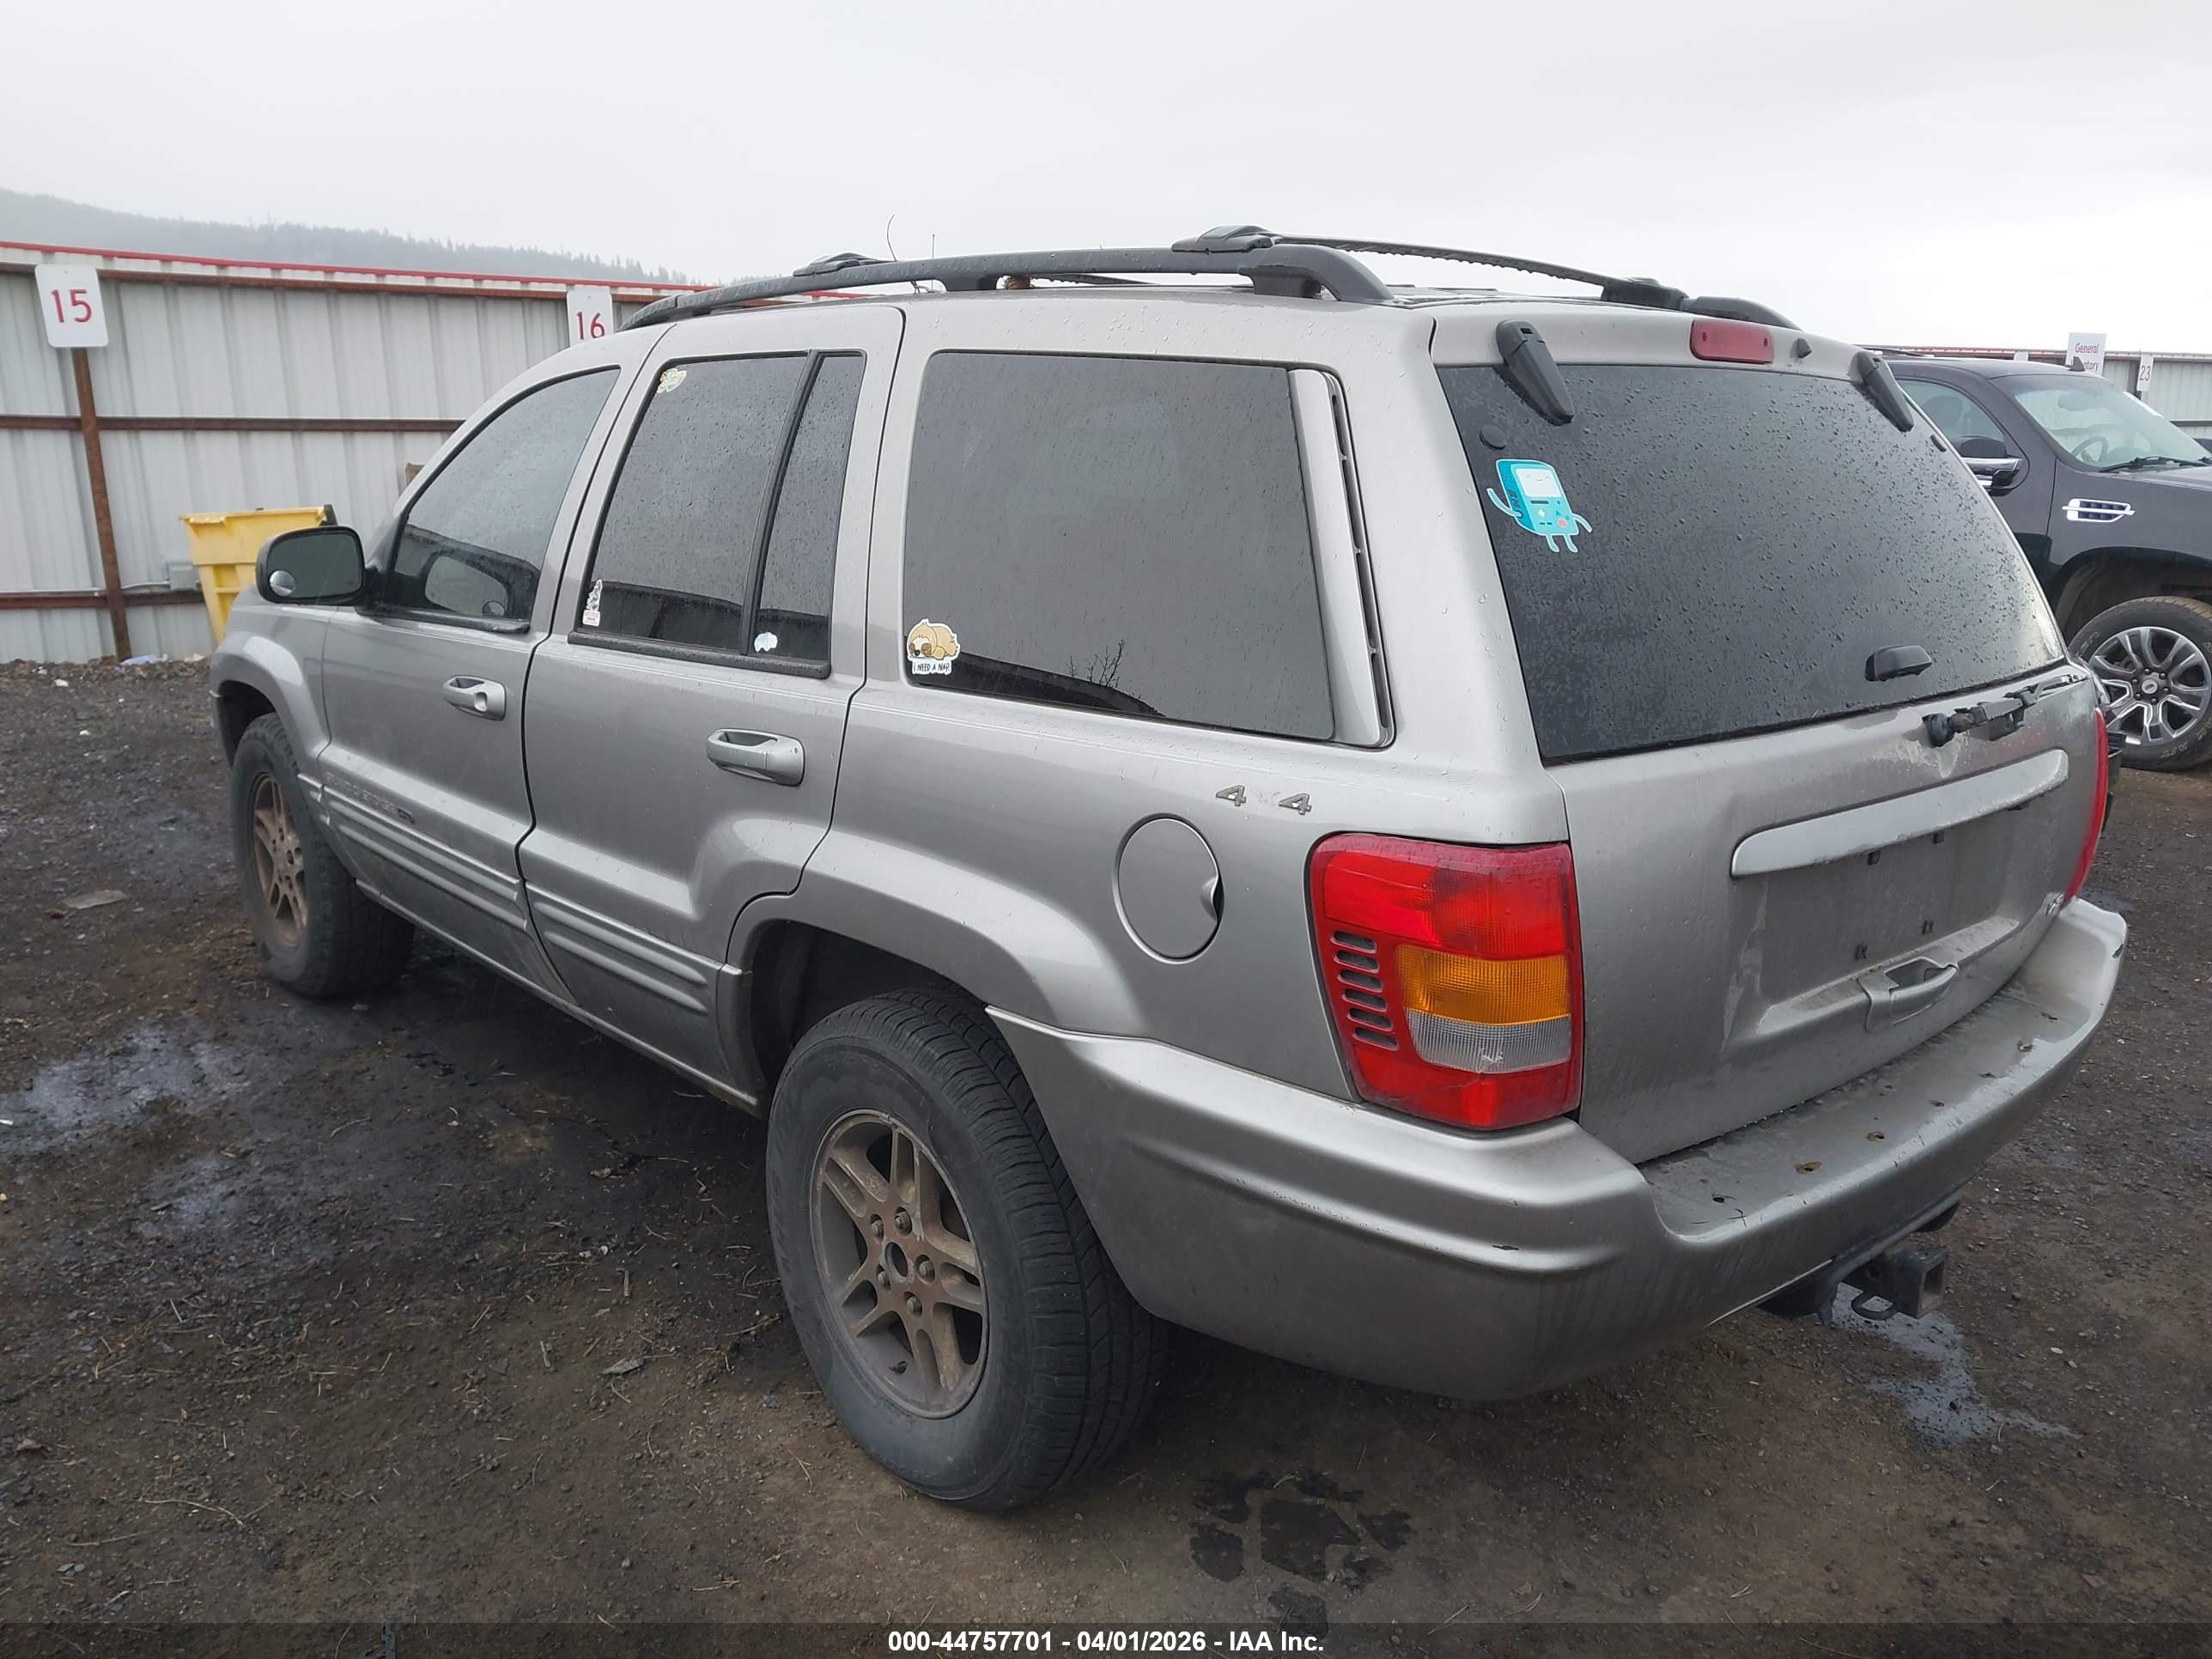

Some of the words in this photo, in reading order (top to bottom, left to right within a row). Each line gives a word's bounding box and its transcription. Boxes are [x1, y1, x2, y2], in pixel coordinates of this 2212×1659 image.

[51, 289, 92, 323] 15
[577, 311, 605, 340] 16
[2075, 343, 2100, 354] General
[2139, 365, 2151, 381] 23
[917, 663, 931, 672] NEED
